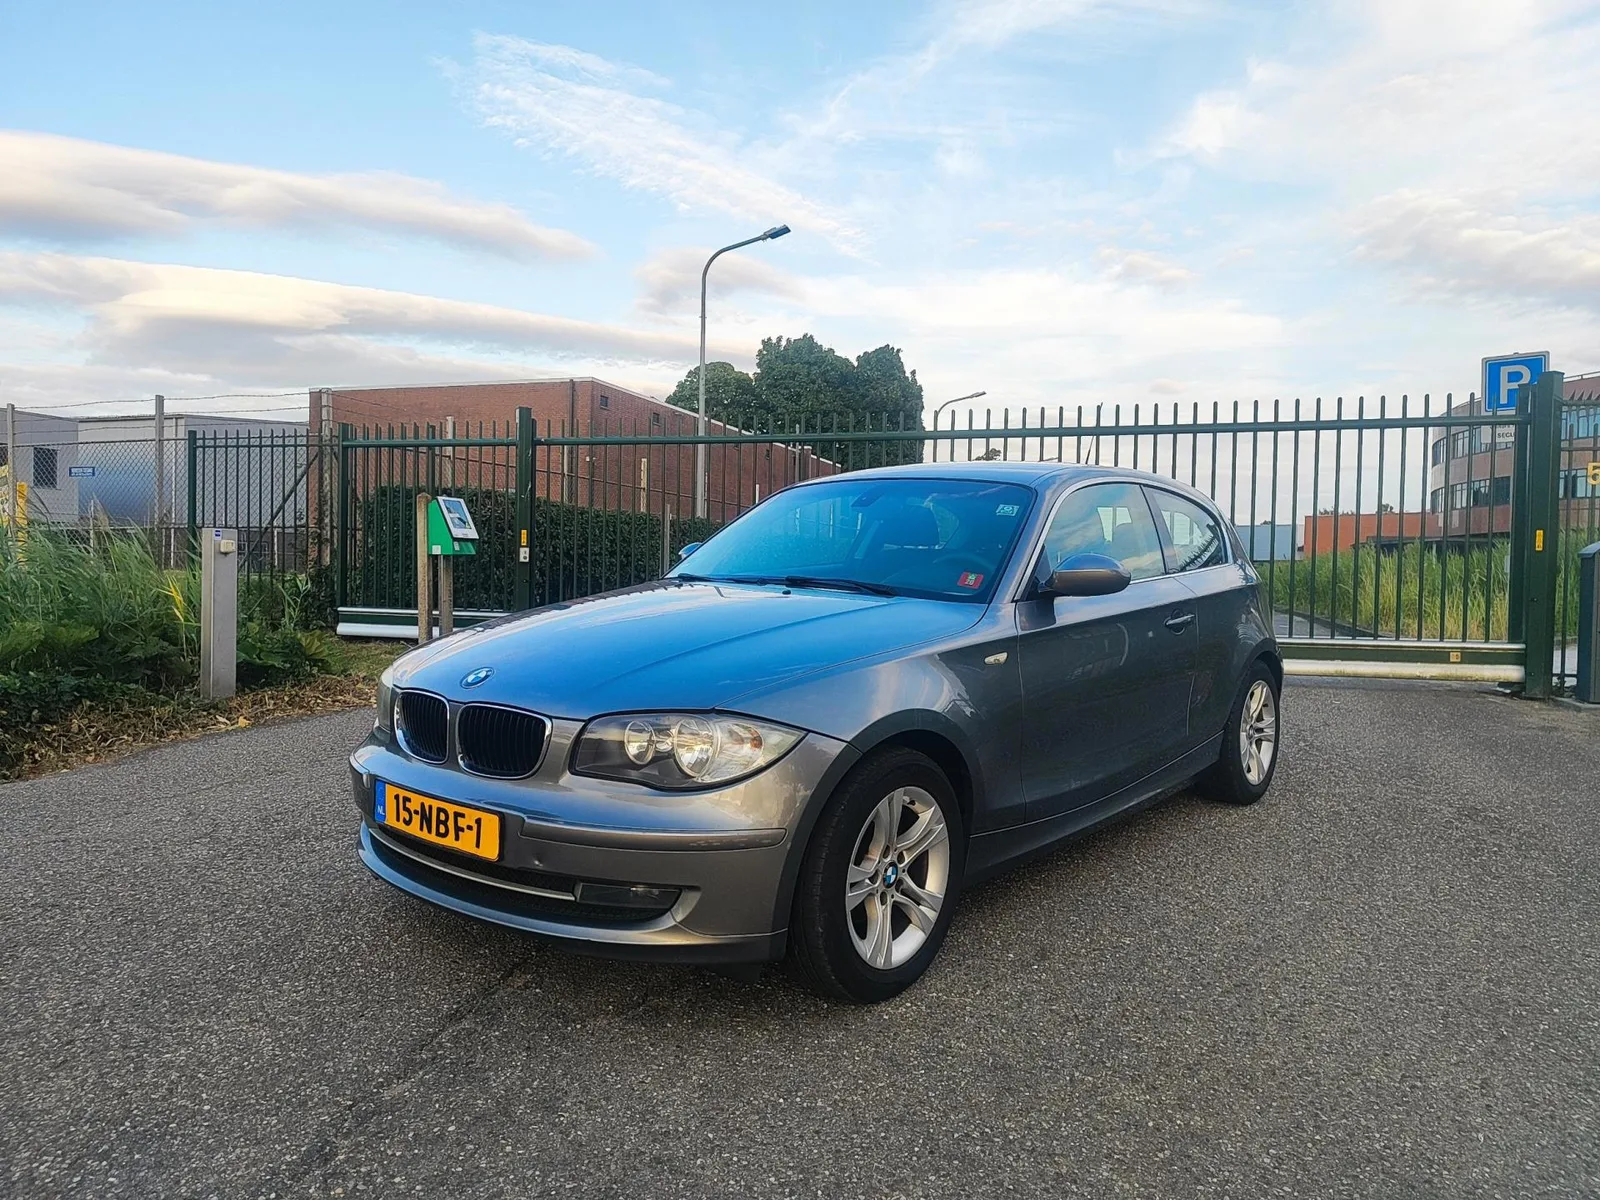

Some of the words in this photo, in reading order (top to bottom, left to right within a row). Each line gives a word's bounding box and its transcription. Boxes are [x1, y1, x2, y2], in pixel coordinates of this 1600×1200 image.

[1500, 364, 1531, 404] P
[377, 804, 386, 815] NL
[393, 793, 482, 849] 15-NBF-1
